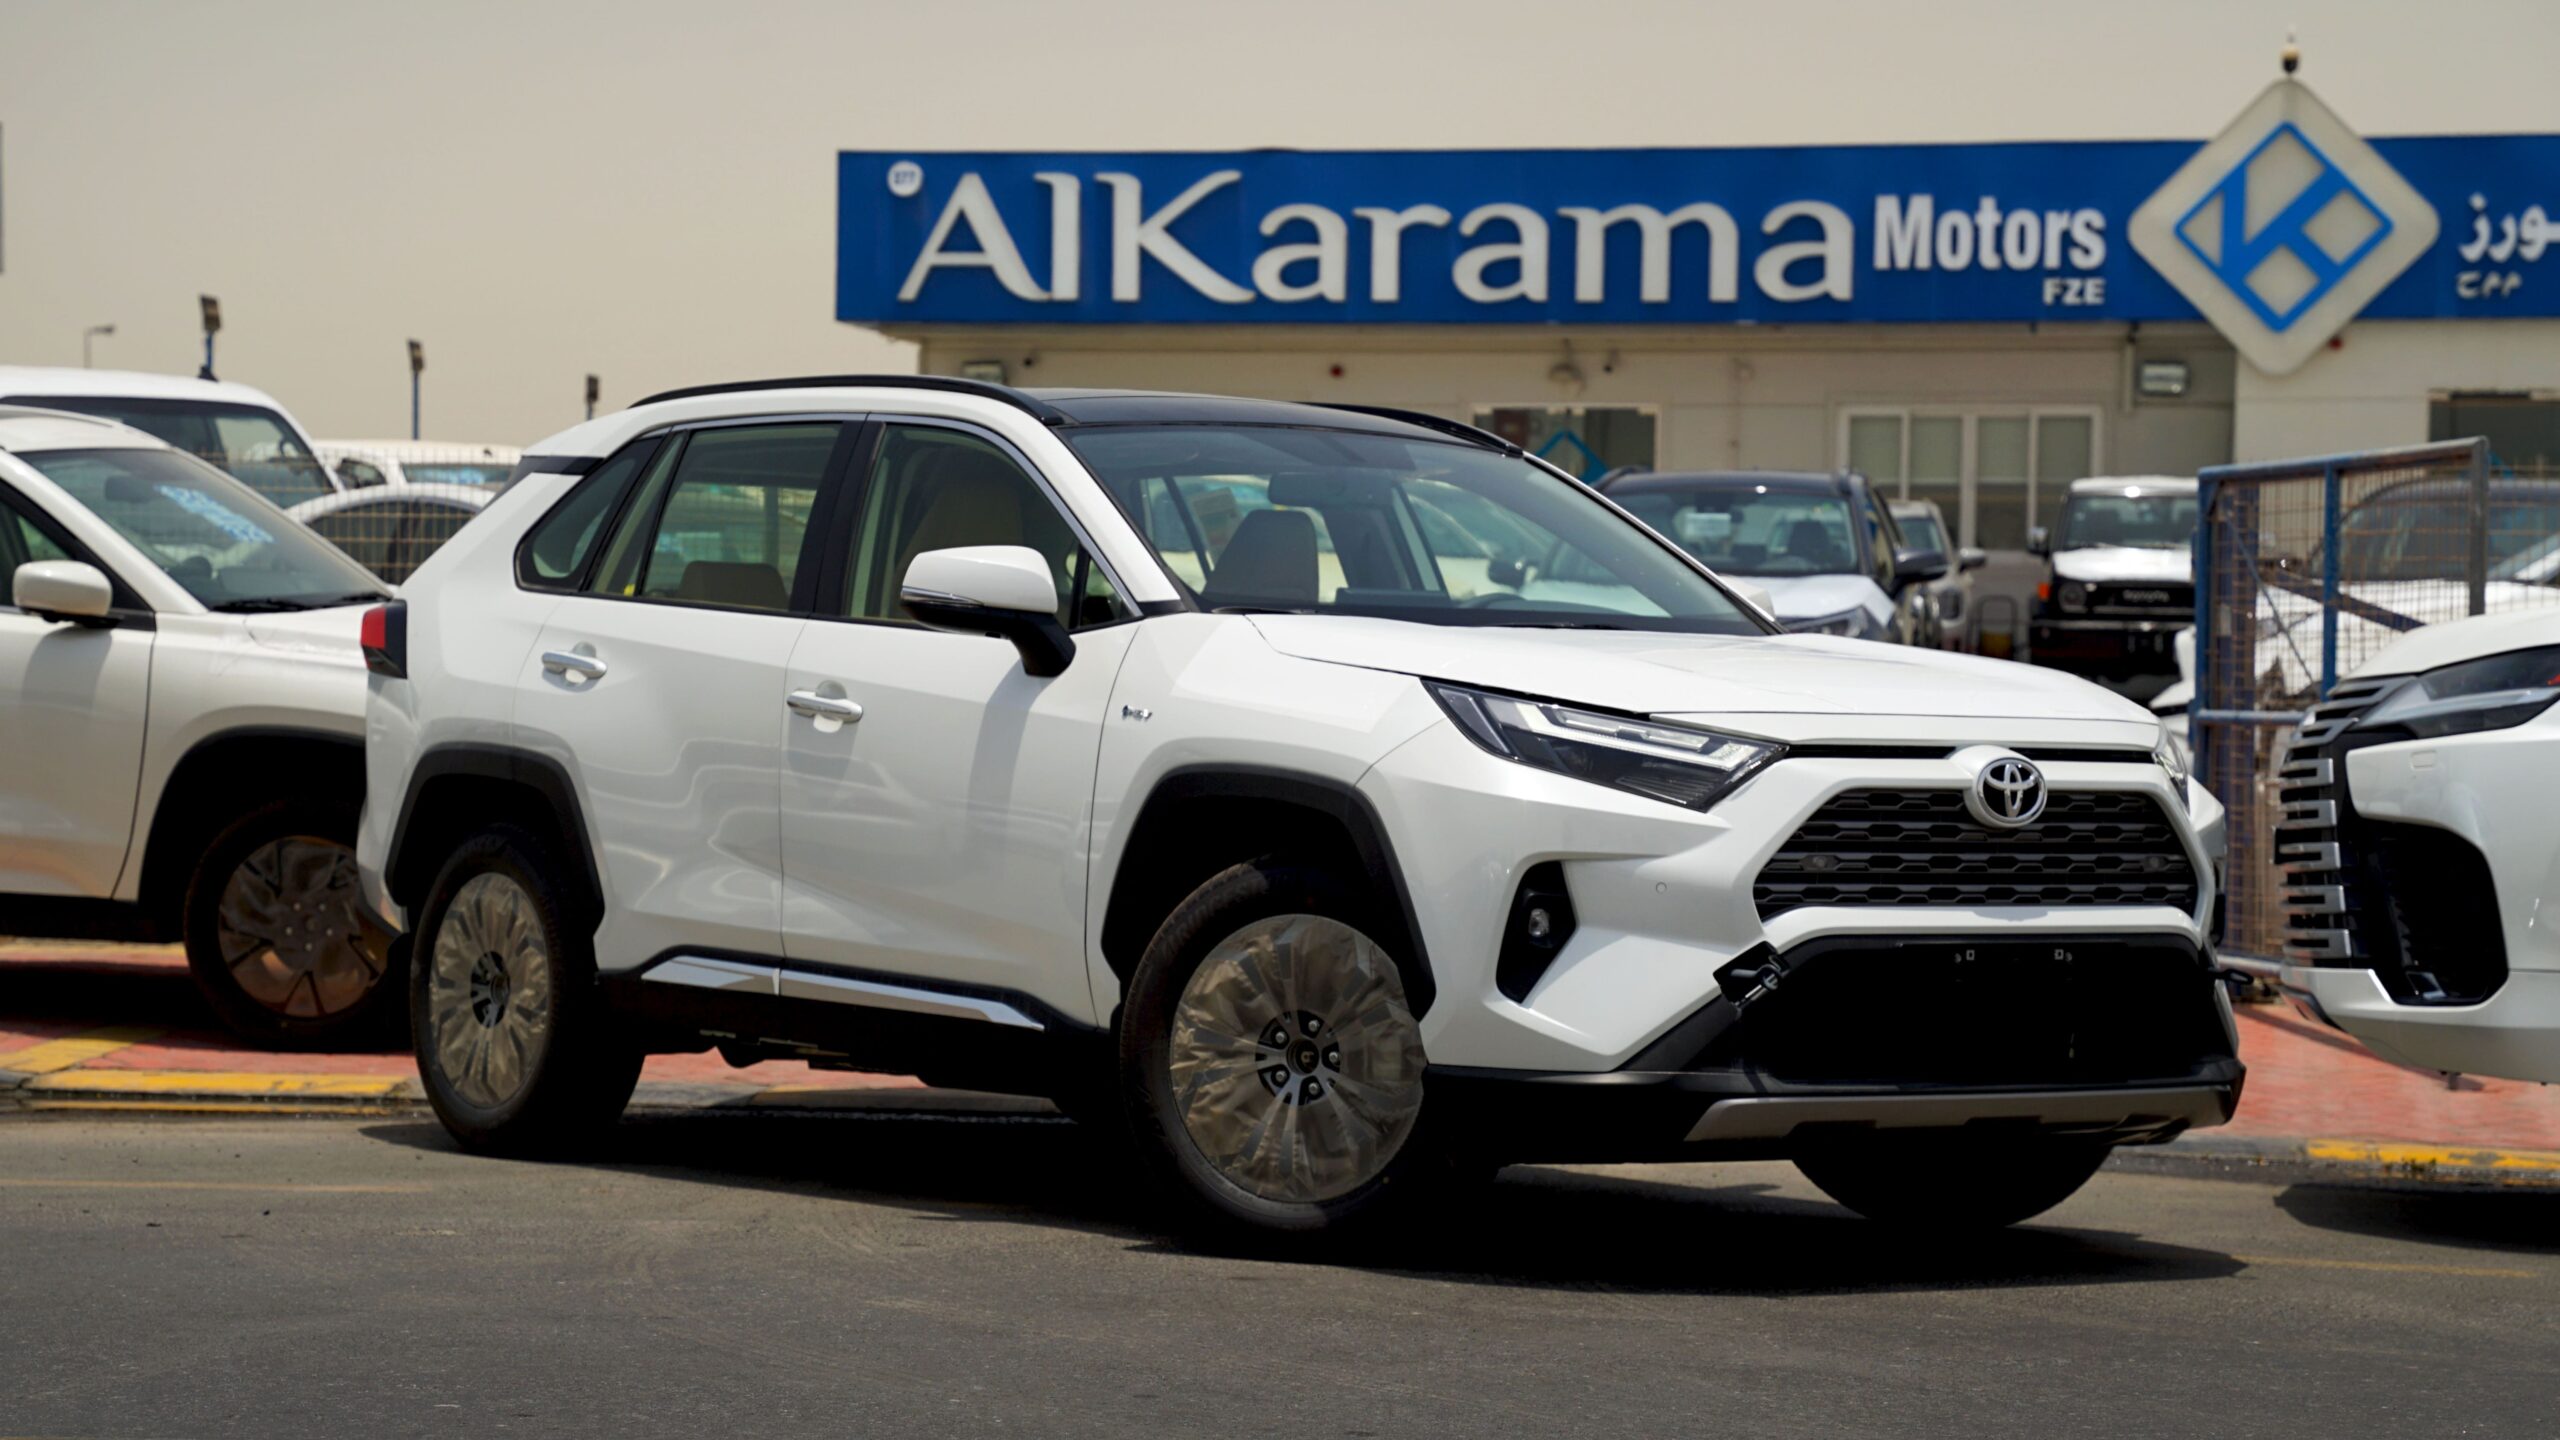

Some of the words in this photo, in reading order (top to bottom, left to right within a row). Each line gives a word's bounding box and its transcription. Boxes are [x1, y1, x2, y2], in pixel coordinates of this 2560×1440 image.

[897, 170, 1855, 304] AlKarama
[1872, 193, 2107, 271] Motors
[2459, 191, 2560, 263] ورز
[2042, 277, 2106, 306] FZE
